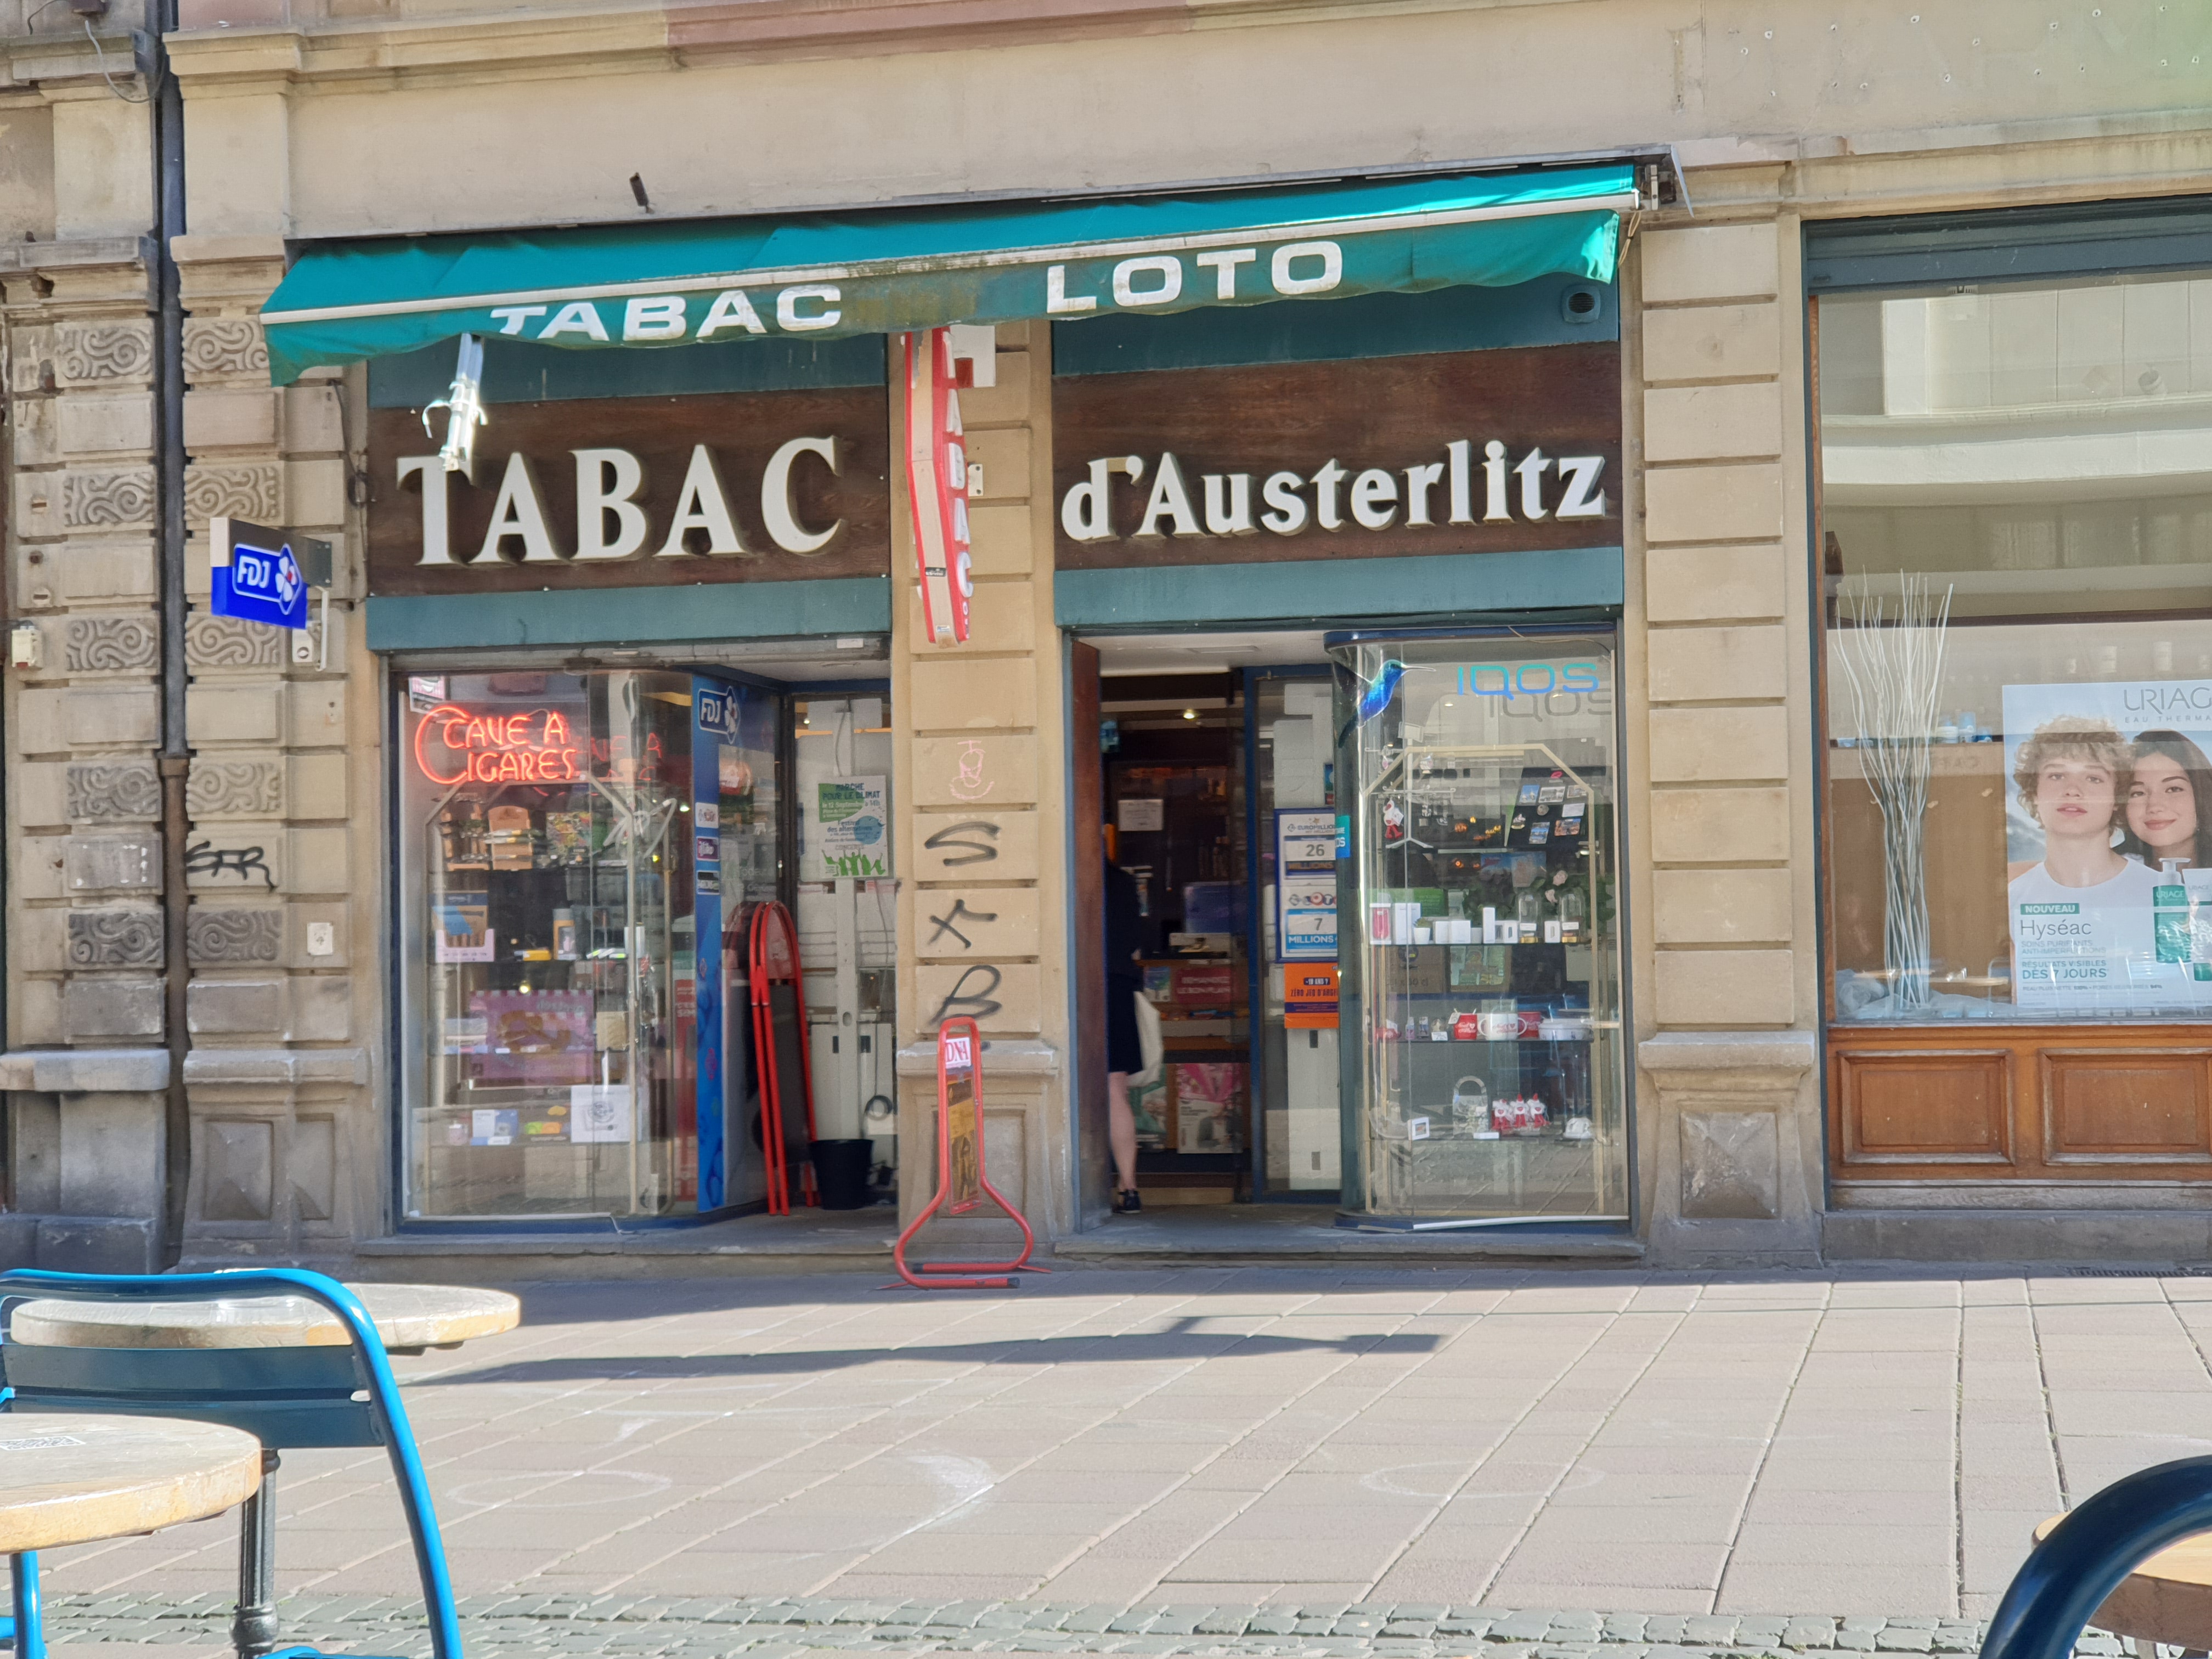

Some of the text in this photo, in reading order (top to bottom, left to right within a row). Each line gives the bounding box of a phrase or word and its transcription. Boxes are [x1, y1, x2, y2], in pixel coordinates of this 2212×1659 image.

[1047, 241, 1342, 313] LOTO
[490, 284, 842, 341] TABAC
[397, 436, 845, 566] TABAC
[1062, 439, 1606, 541] d'Austerlitz
[237, 556, 270, 588] FDJ
[1457, 663, 1599, 701] IQOS
[702, 698, 721, 723] FDJ
[443, 715, 532, 749] CAVE
[1306, 844, 1325, 856] 26
[1314, 918, 1323, 930] 7
[2025, 905, 2075, 913] NOUVEAU
[1289, 935, 1334, 944] MILLIONS
[2020, 919, 2092, 940] Hyséac
